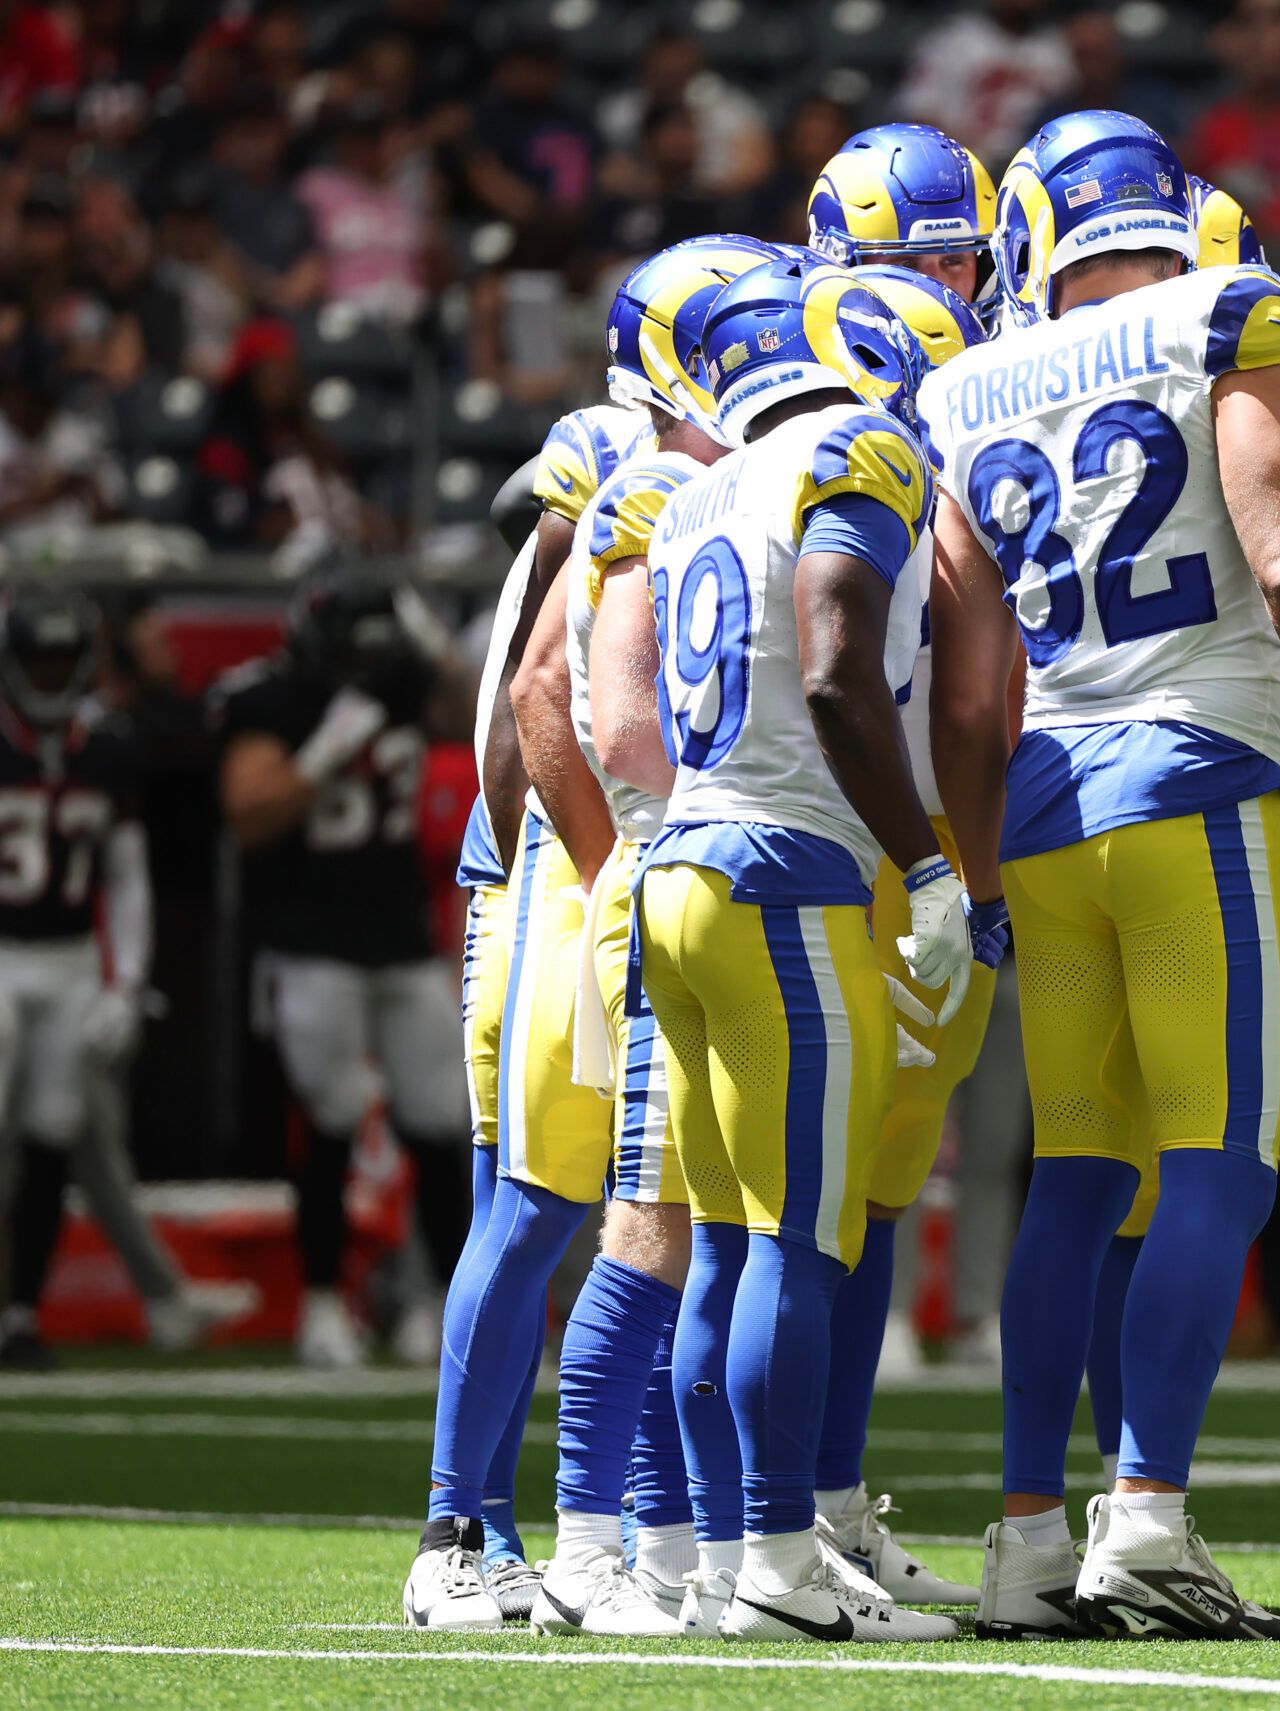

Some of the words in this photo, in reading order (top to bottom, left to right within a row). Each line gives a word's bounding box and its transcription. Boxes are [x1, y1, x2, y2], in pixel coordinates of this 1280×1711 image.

[924, 221, 962, 232] RAMS
[1075, 226, 1112, 247] LOS
[1114, 219, 1189, 234] ANGELES
[761, 338, 779, 350] NFL
[730, 369, 804, 408] ANGELES
[946, 317, 1170, 443] FORRISTALL
[662, 457, 747, 544] SMITH
[967, 399, 1219, 670] 82
[915, 869, 936, 885] CAMP
[1180, 1587, 1223, 1621] ALPHA
